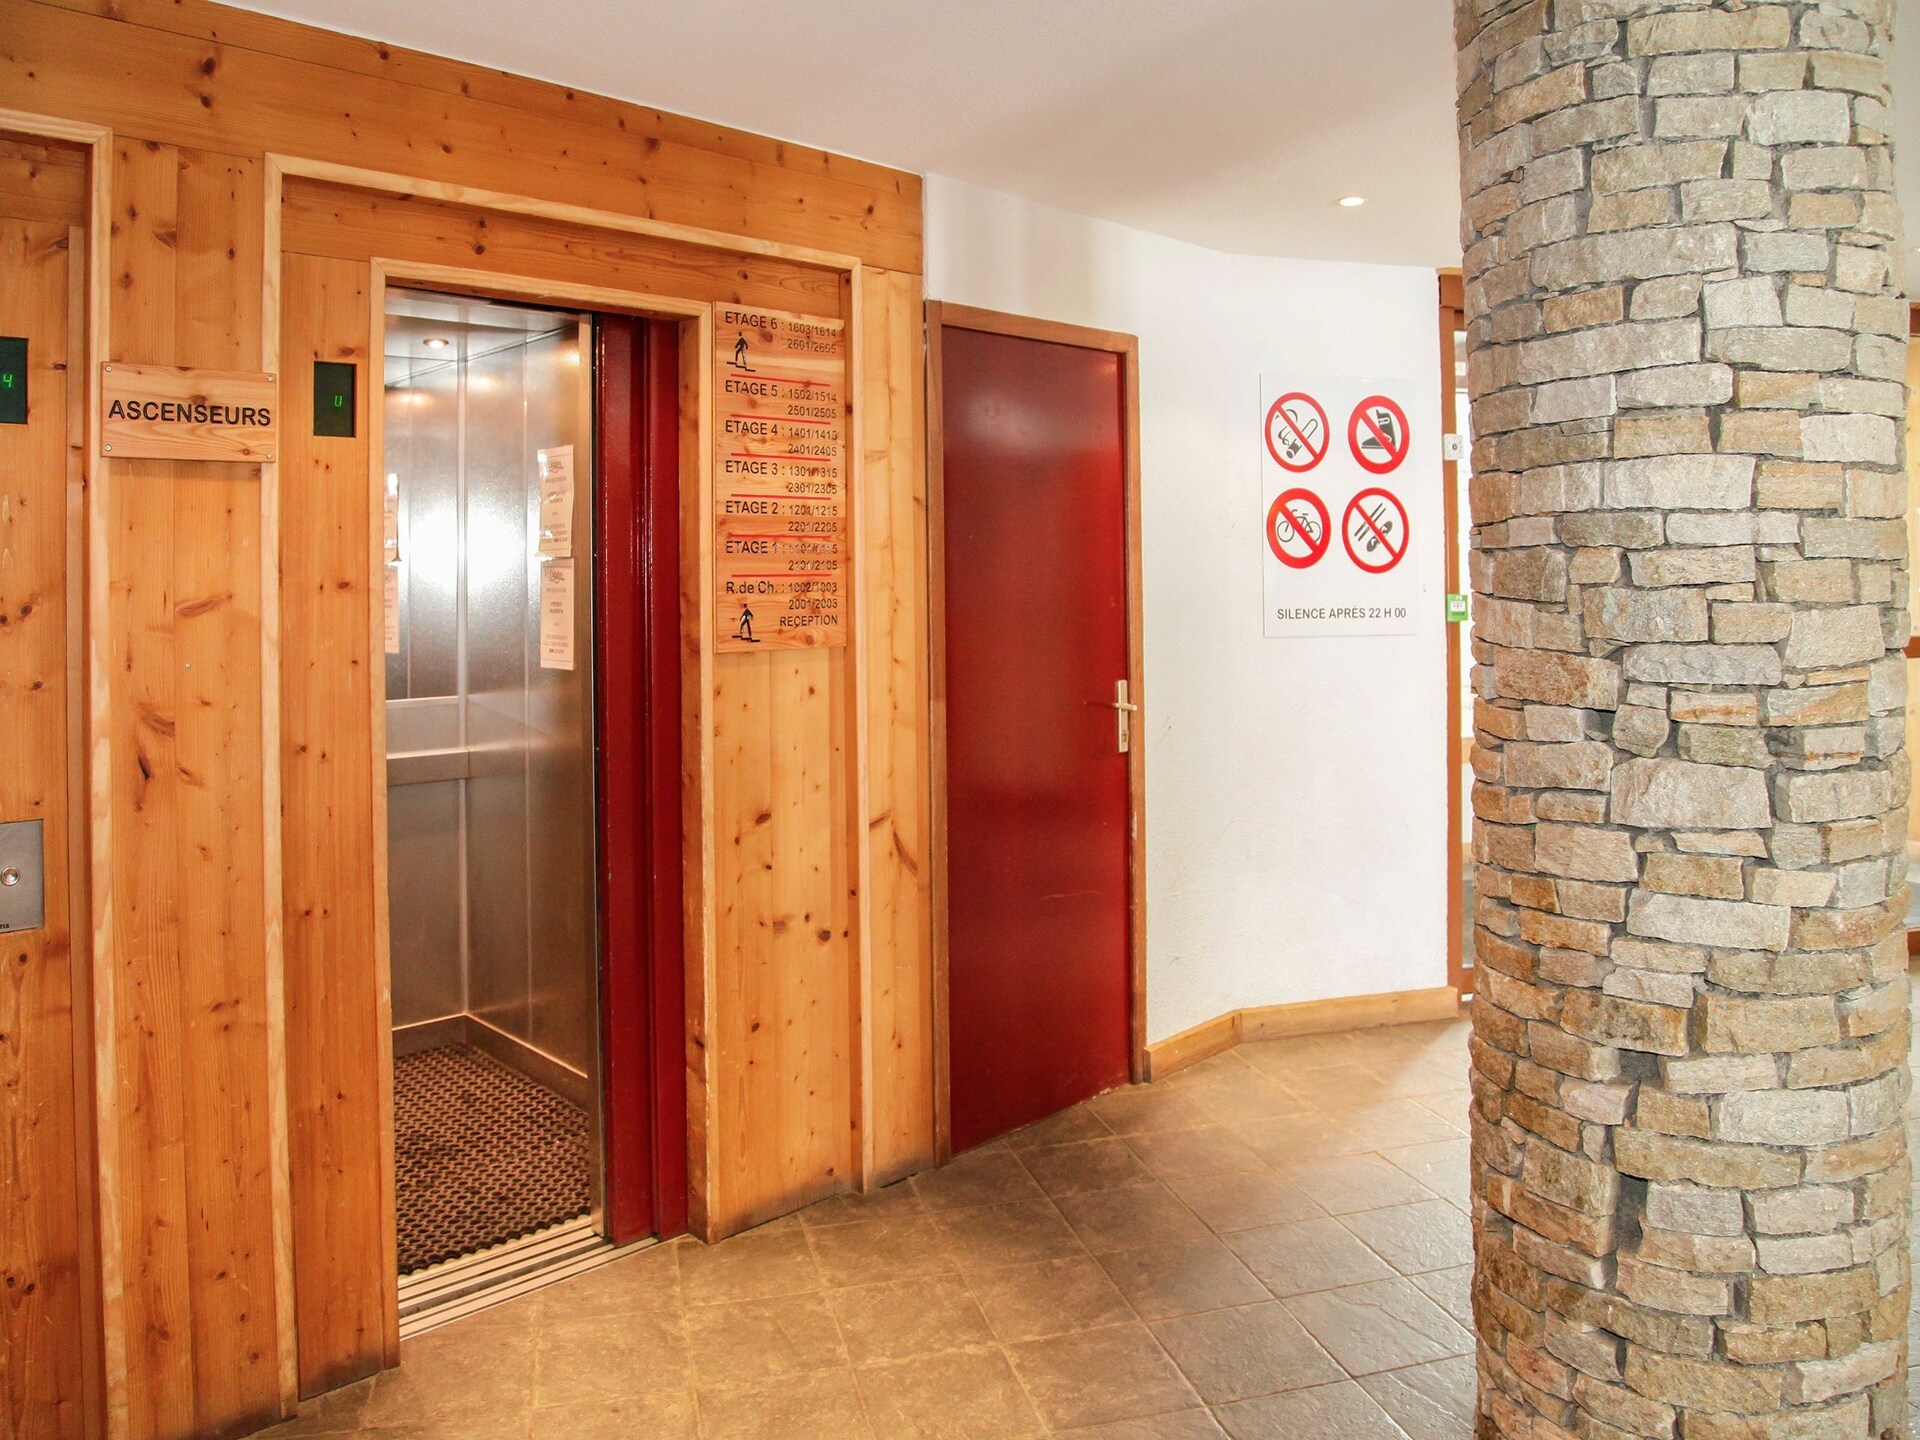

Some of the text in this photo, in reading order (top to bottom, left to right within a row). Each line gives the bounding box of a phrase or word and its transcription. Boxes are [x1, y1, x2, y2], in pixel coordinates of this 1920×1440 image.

[725, 311, 767, 329] ETAGE
[770, 317, 778, 330] 6
[788, 322, 837, 337] 1603/1614
[3, 374, 13, 388] 4
[725, 379, 767, 396] ETAGE
[771, 385, 778, 397] 5
[788, 388, 837, 402] 1502/1514
[108, 399, 271, 427] ASCENSEURS
[787, 404, 837, 419] 2501/2505
[725, 419, 768, 435] ETAGE
[770, 424, 778, 436] 4
[788, 427, 838, 441] 1401/1415
[787, 443, 837, 457] 2401/2405
[725, 460, 768, 475] ETAGE
[771, 462, 779, 475] 3
[788, 465, 838, 478] 1301/1315
[787, 482, 838, 494] 2301/2305
[725, 501, 768, 514] ETAGE
[771, 502, 779, 515] 2
[725, 541, 768, 554] ETAGE
[772, 541, 778, 554] 1
[1277, 605, 1407, 620] SILENCE APRÈS 22 H 00
[779, 615, 838, 627] RECEPTION
